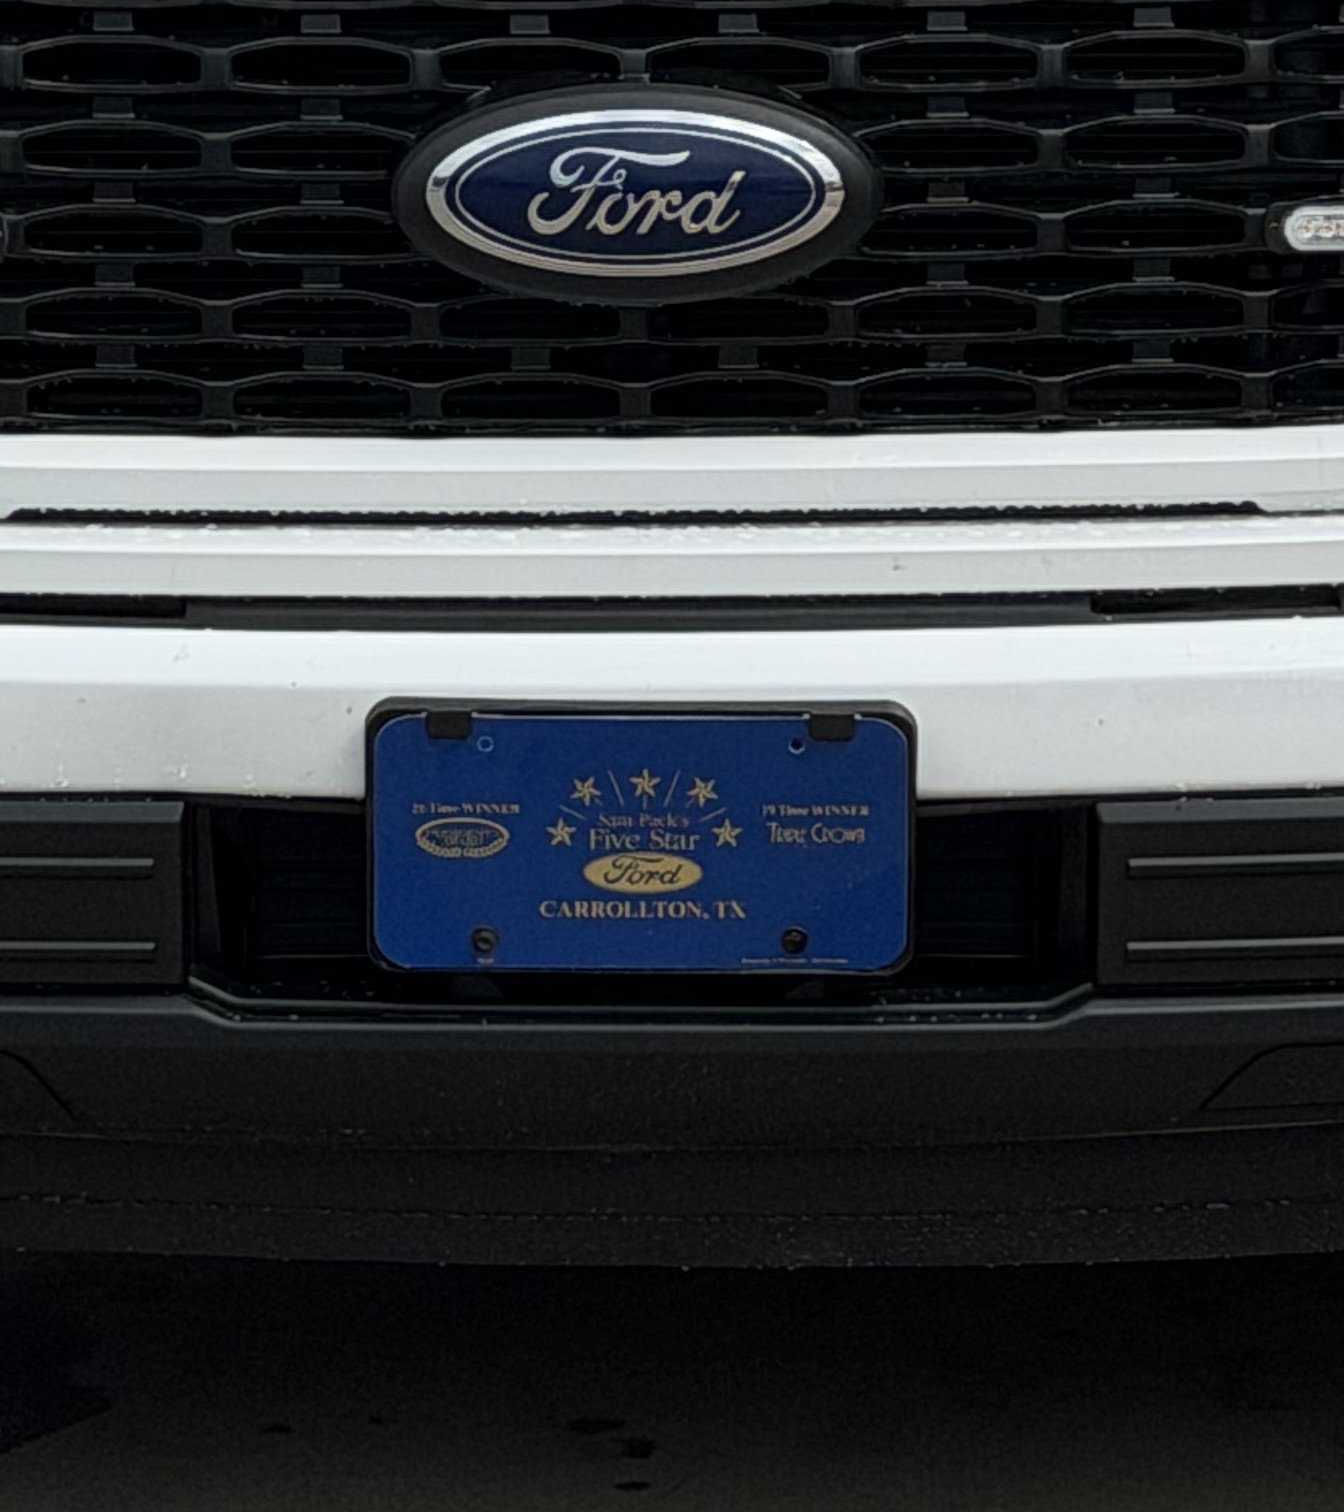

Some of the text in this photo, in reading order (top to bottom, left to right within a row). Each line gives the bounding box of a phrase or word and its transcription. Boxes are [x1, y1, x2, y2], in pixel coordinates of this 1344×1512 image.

[527, 146, 746, 236] Ford
[589, 828, 700, 850] Five Star
[603, 855, 683, 885] Ford
[539, 899, 747, 919] CARROLLTON, TX
